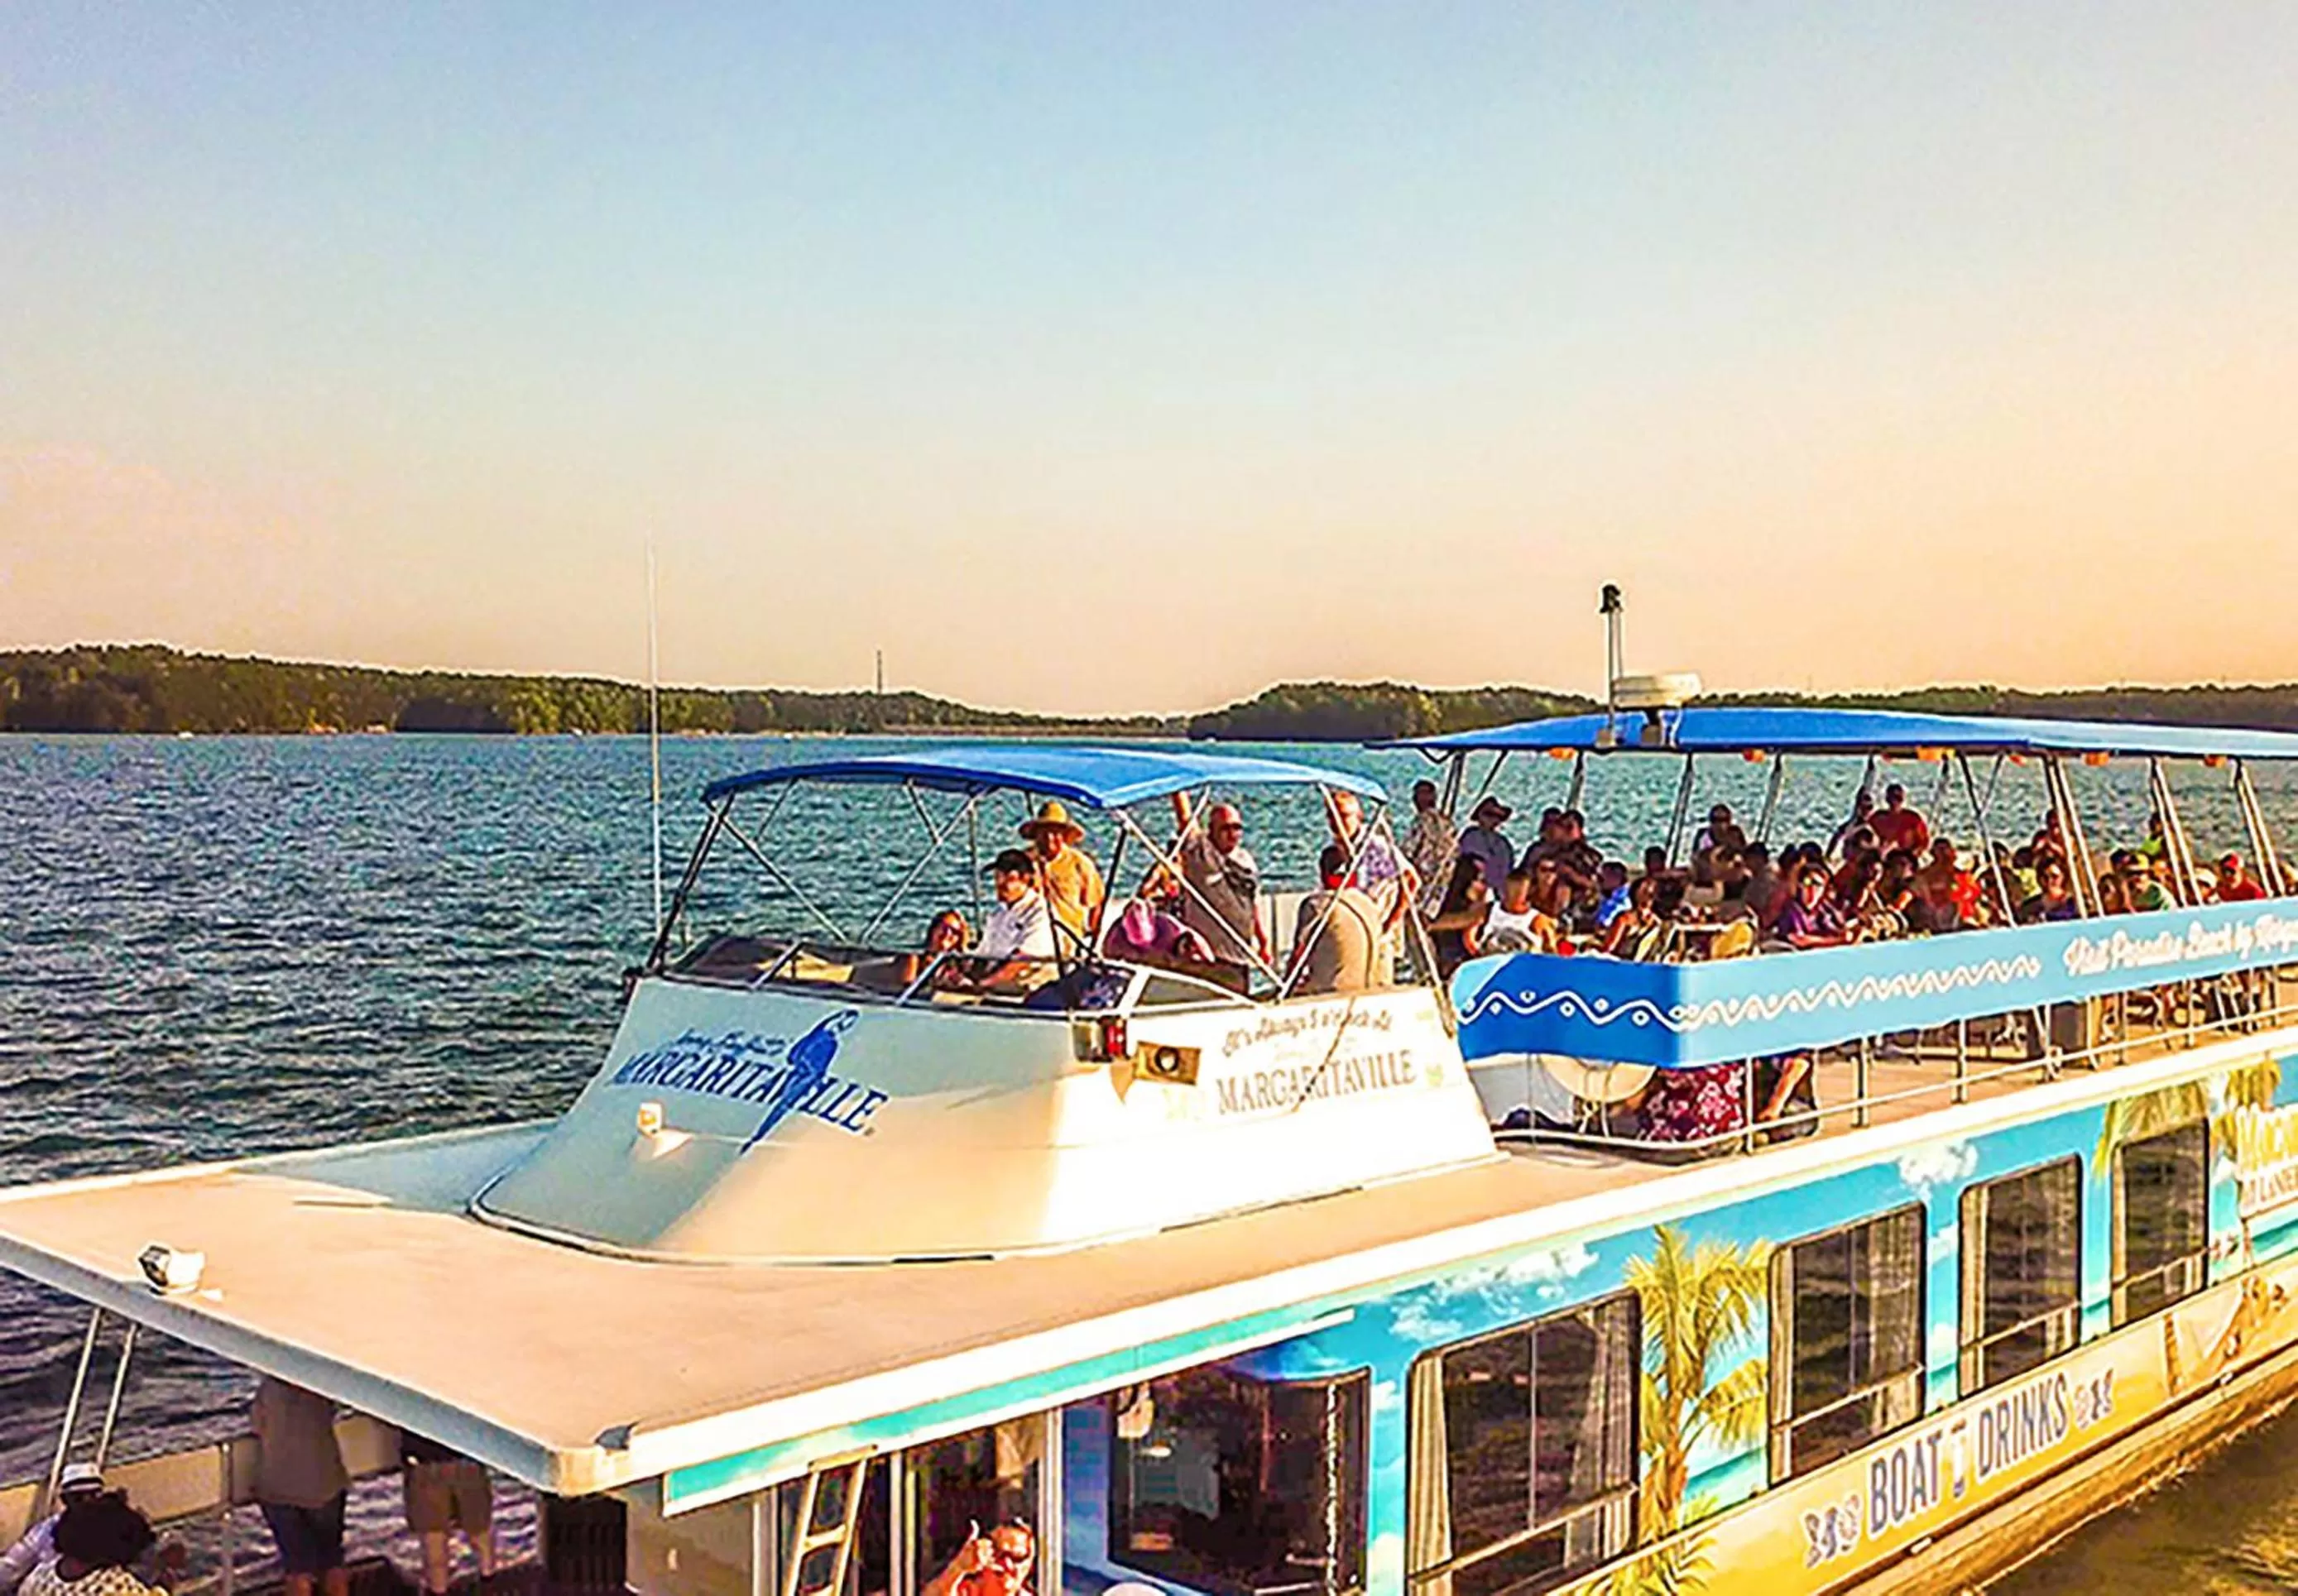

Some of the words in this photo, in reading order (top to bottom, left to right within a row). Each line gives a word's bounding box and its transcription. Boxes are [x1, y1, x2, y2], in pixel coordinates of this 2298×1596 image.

[1216, 1048, 1418, 1116] MARGARITAVILLE
[1869, 1431, 1942, 1534] BOAT
[1978, 1372, 2068, 1479] DRINKS
